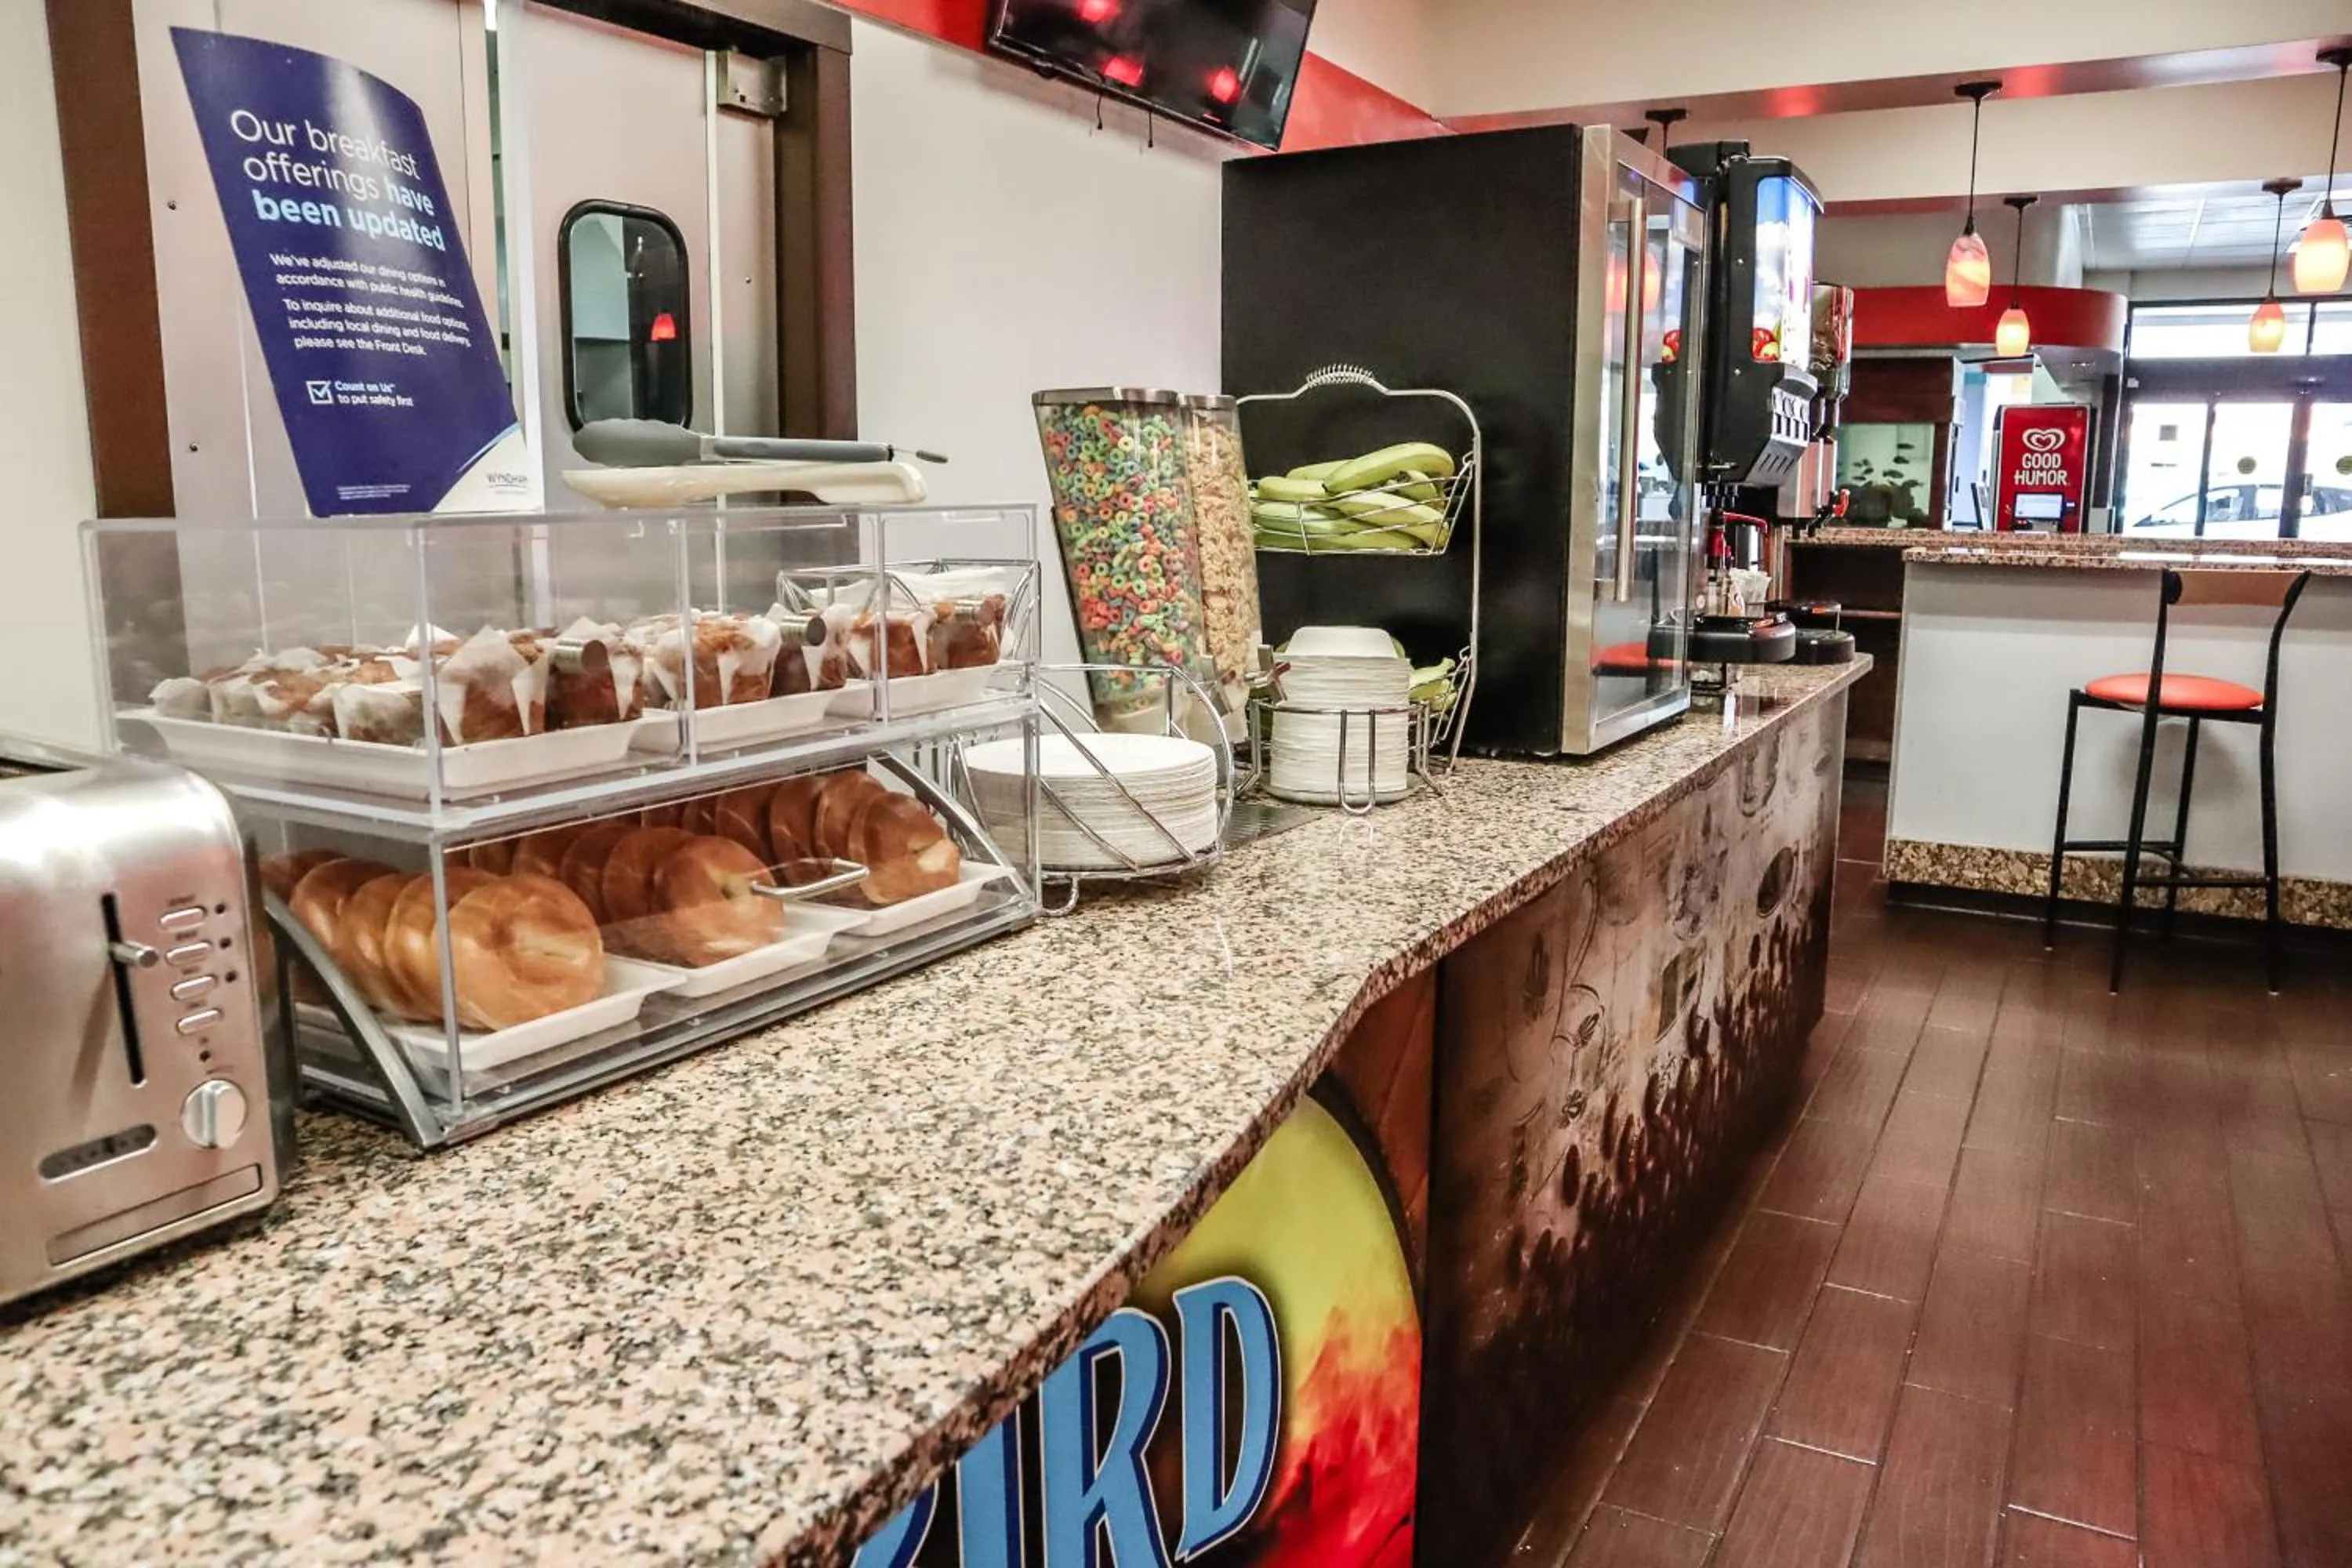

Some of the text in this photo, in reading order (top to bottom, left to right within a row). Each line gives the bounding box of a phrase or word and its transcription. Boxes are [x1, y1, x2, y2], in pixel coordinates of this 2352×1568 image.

[230, 108, 420, 180] Our breakfast
[243, 152, 434, 216] offerings have
[252, 190, 446, 252] been updated
[269, 252, 310, 267] We've
[312, 256, 358, 272] adjusted
[360, 263, 376, 274] our
[378, 266, 406, 281] dining
[408, 271, 438, 286] options
[276, 273, 346, 288] accordance
[346, 279, 368, 290] with
[369, 281, 399, 295] public
[399, 285, 427, 299] health
[282, 299, 301, 311] To
[301, 299, 343, 314] inquire
[344, 302, 375, 316] about
[376, 307, 420, 322] additional
[420, 310, 441, 325] food
[287, 316, 344, 332] including
[344, 318, 371, 332] local
[371, 322, 401, 338] dining
[401, 327, 420, 339] and
[419, 327, 441, 341] food
[294, 335, 335, 350] please
[335, 338, 356, 349] see
[355, 338, 375, 350] the
[375, 339, 402, 352] Front
[334, 380, 365, 392] Count
[366, 382, 379, 392] on
[337, 394, 350, 405] to
[350, 394, 369, 405] put
[369, 394, 396, 407] safety
[2022, 452, 2061, 469] GOOD
[2014, 470, 2067, 485] HUMOR
[851, 1276, 1282, 1568] IRD
